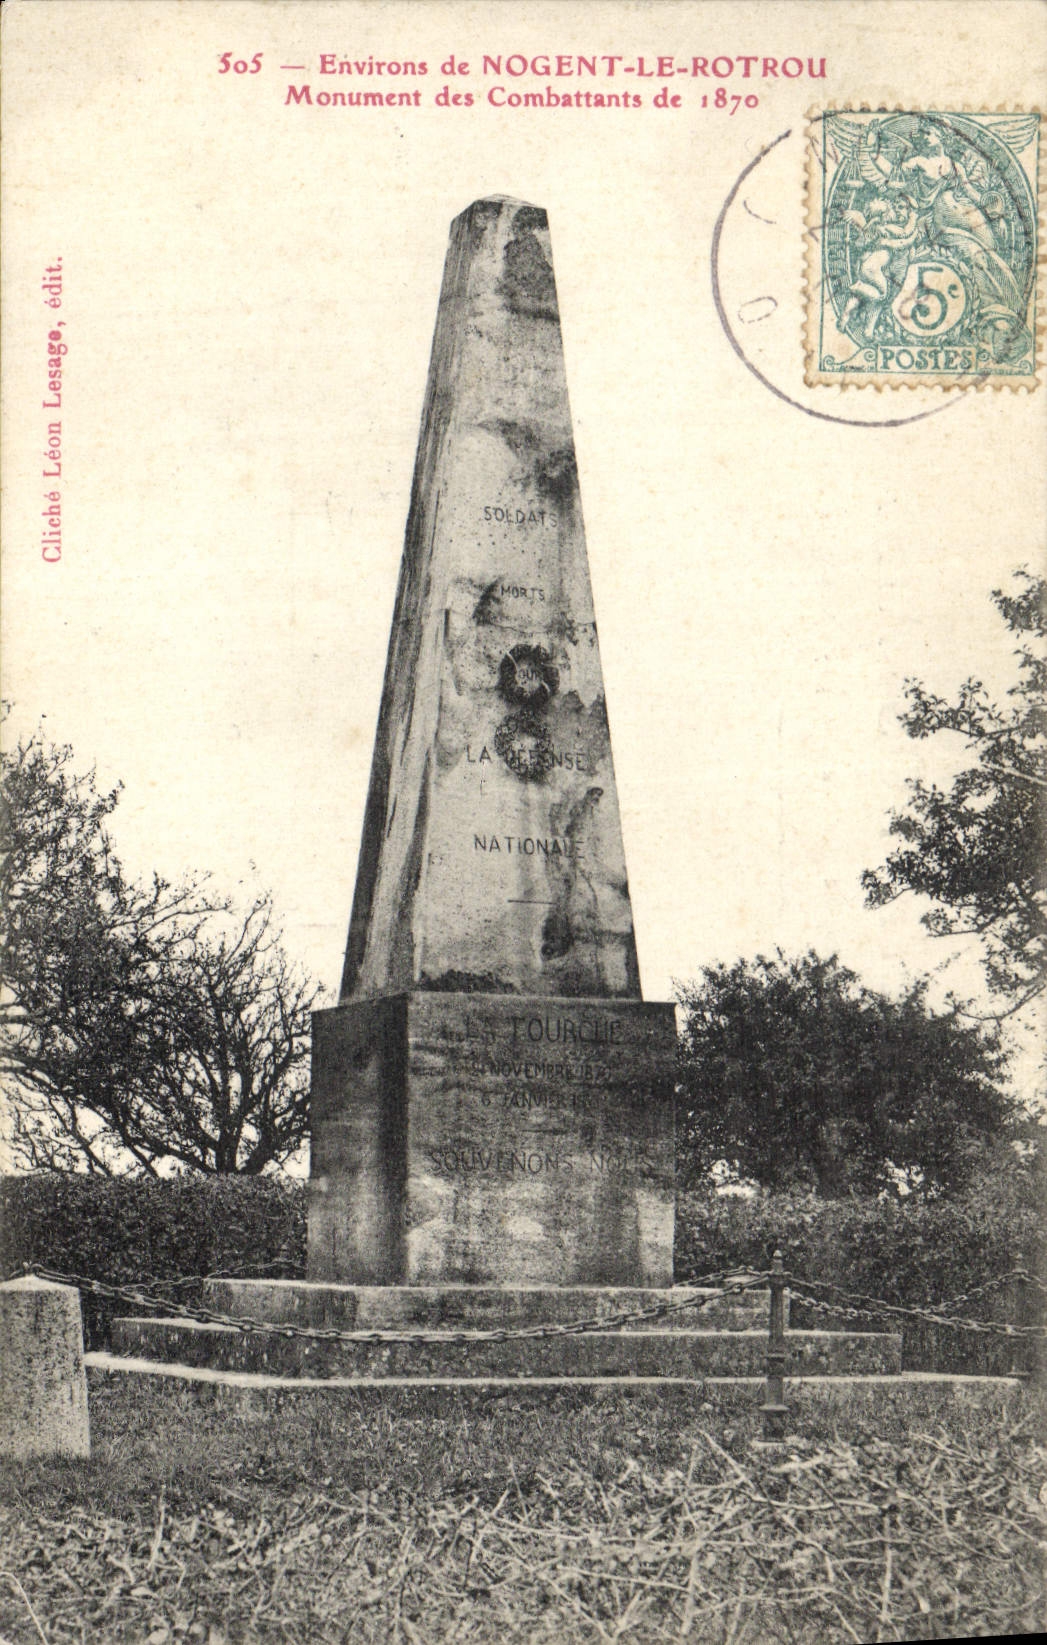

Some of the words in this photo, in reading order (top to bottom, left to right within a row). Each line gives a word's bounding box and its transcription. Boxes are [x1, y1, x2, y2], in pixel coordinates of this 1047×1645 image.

[880, 347, 973, 369] POSTES
[483, 505, 557, 528] SOLDATS
[500, 584, 545, 601] MORTS
[466, 743, 493, 763] LA
[473, 833, 584, 859] NATIONALE
[430, 1149, 573, 1175] SOUVENONS
